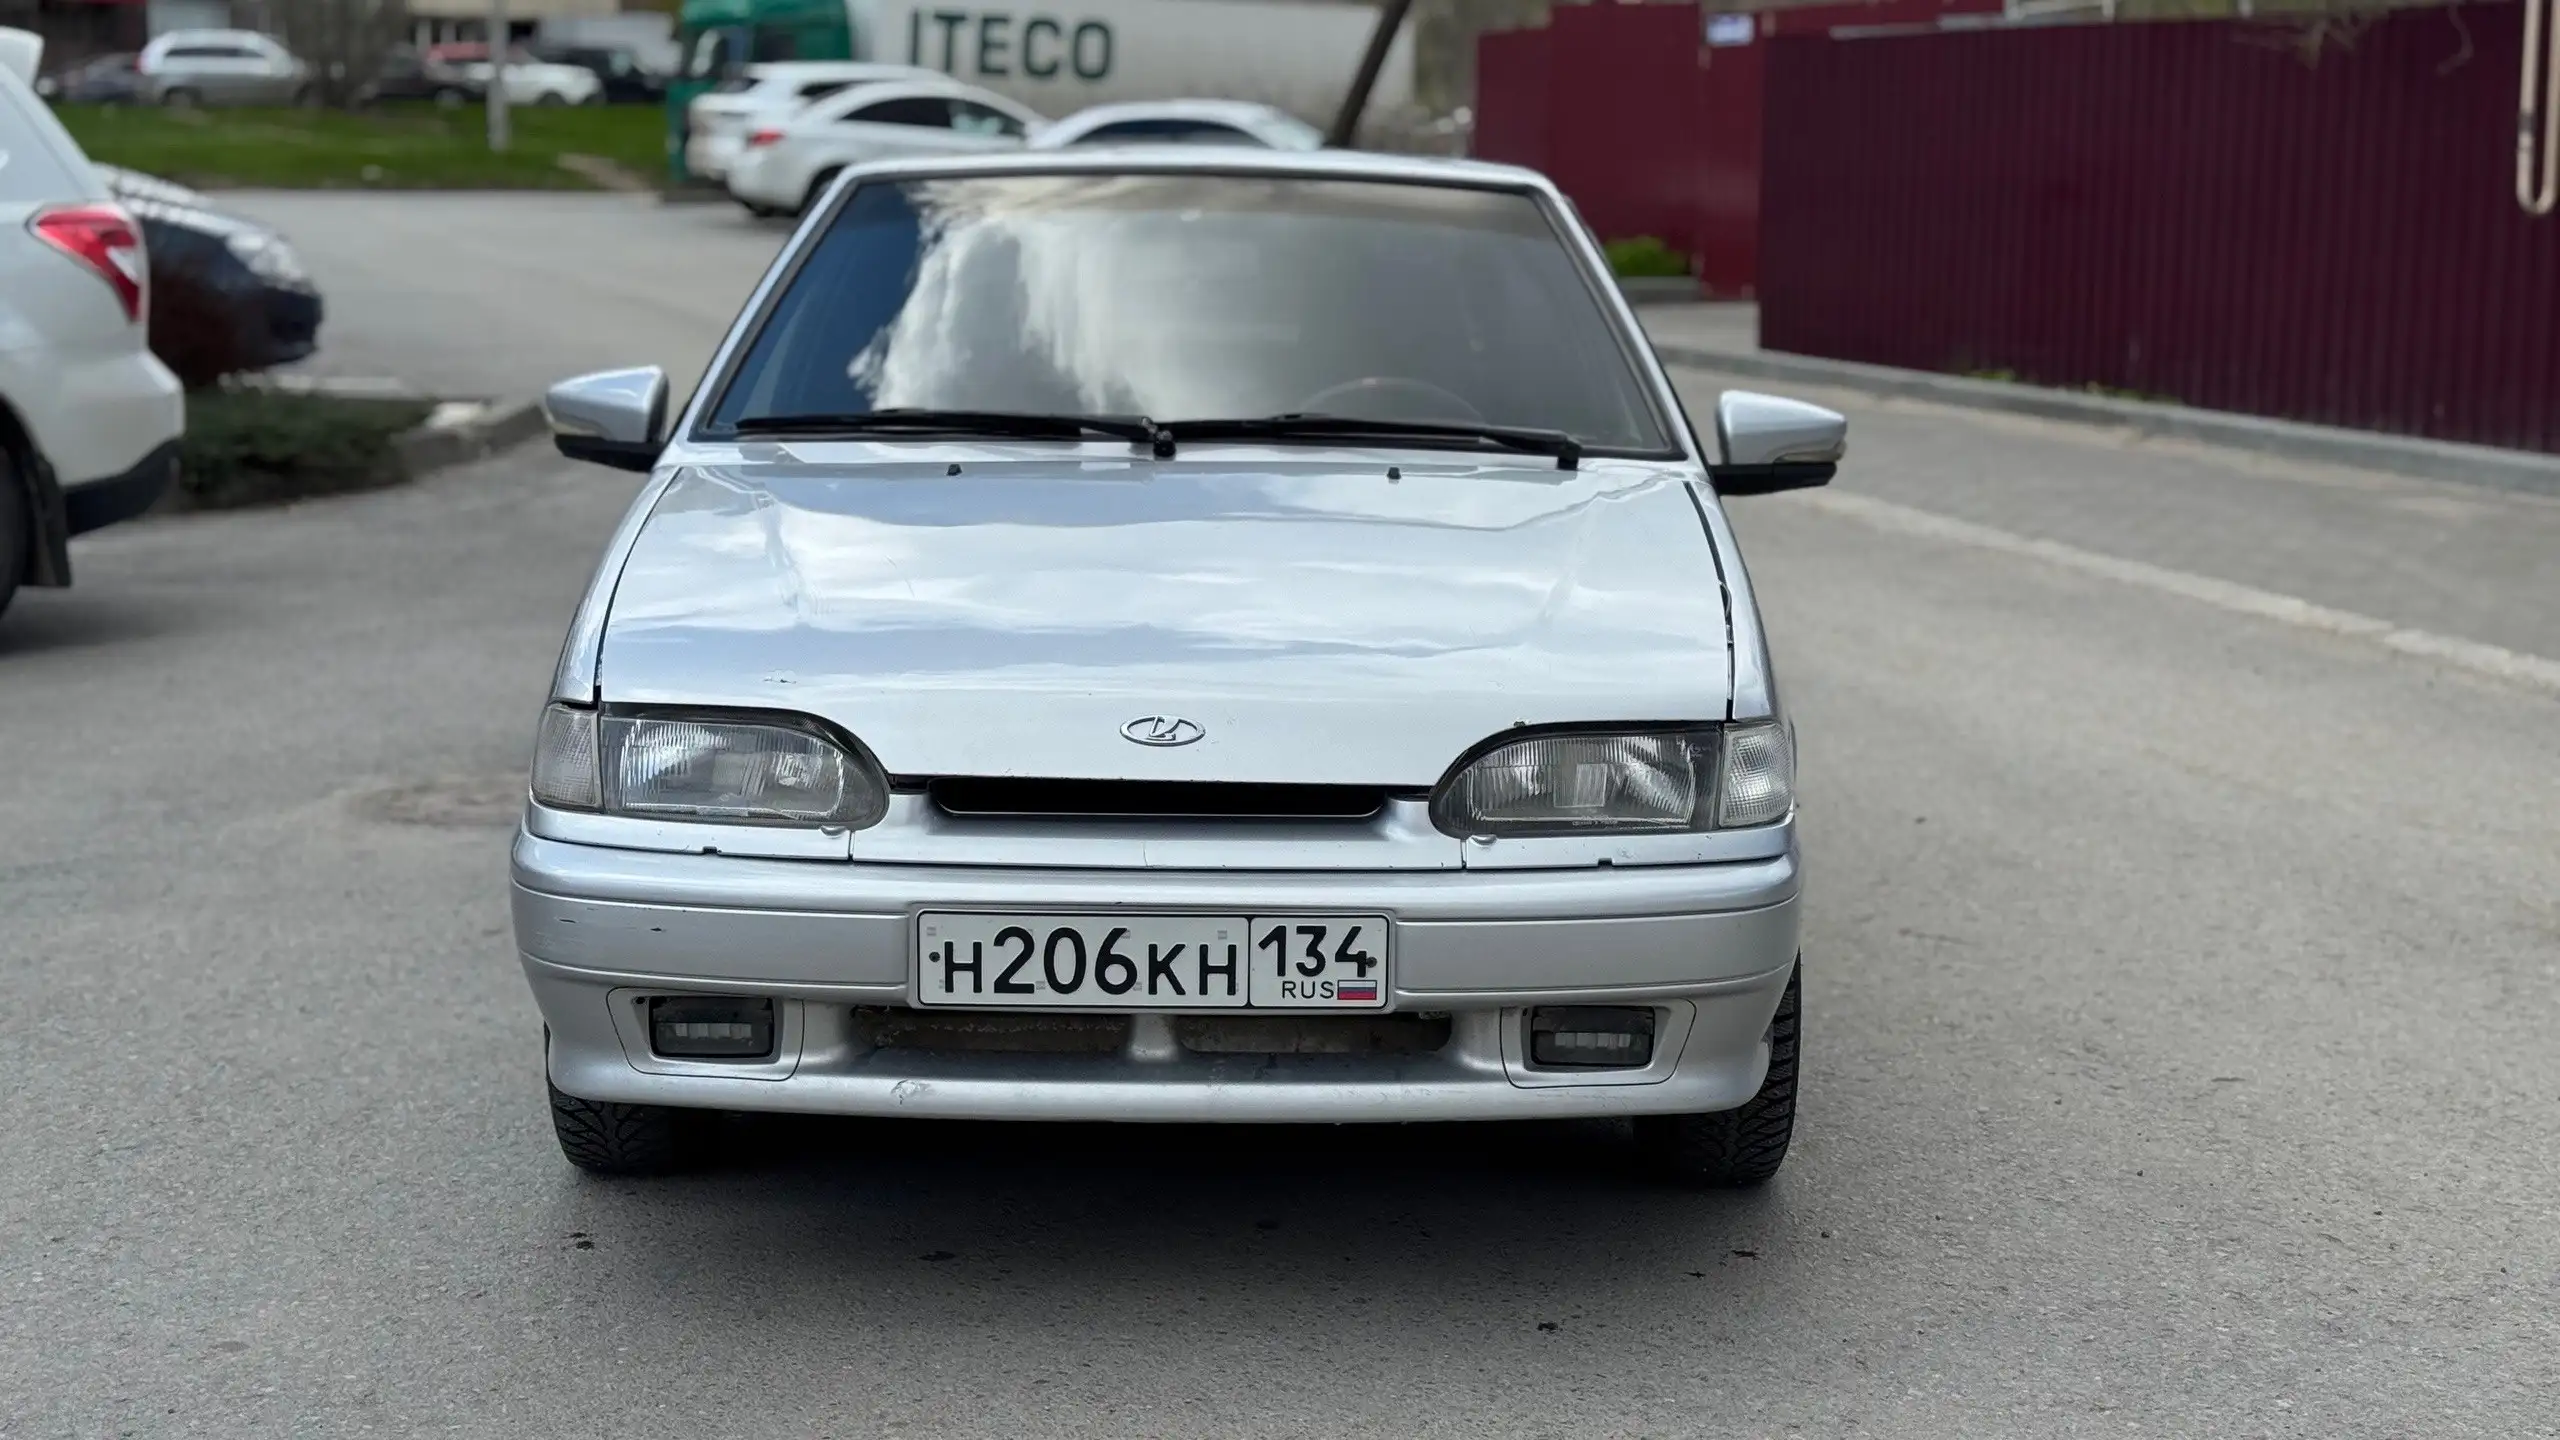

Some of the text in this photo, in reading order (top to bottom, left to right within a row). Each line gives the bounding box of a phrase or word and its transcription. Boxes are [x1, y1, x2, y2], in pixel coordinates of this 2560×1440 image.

[909, 10, 1112, 80] ITECO
[1258, 925, 1367, 978] 134
[1282, 980, 1334, 999] RUS
